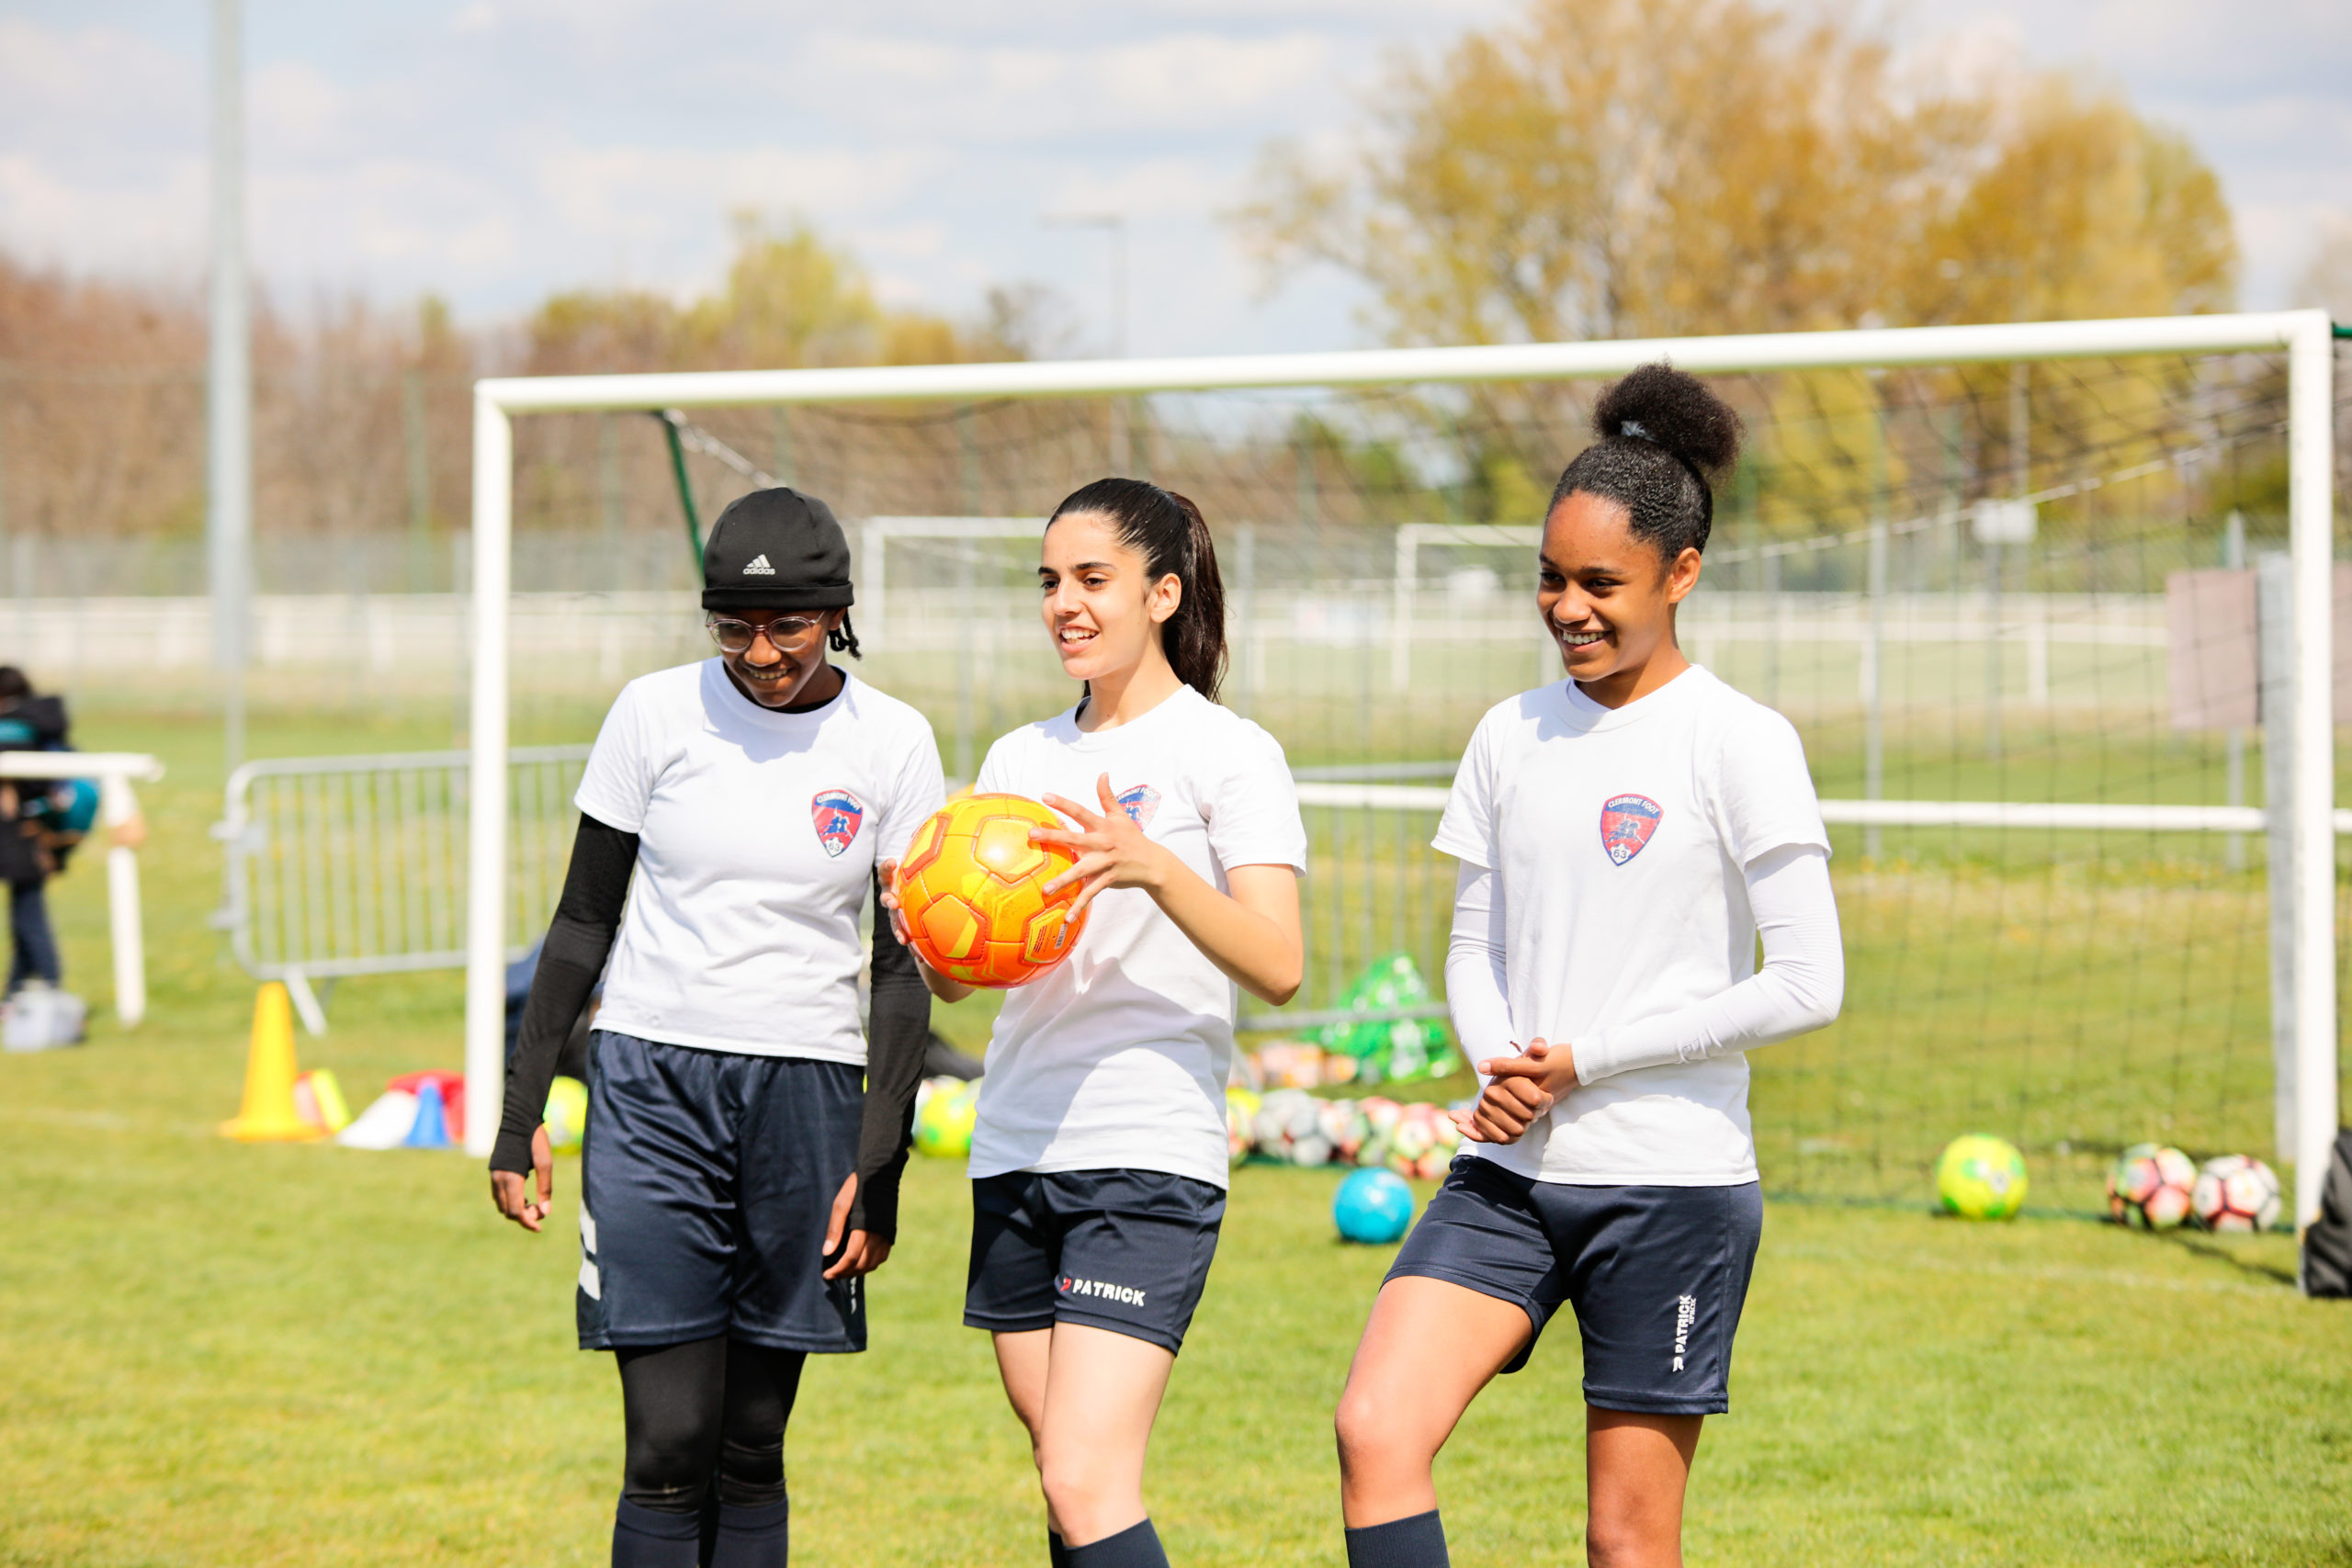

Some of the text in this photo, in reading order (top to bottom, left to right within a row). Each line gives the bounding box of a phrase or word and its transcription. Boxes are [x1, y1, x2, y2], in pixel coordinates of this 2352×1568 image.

[1608, 796, 1660, 814] CLERMONT FOOT
[1612, 849, 1627, 859] 63
[1072, 1278, 1146, 1307] PATRICK
[1675, 1294, 1691, 1354] PATRICK
